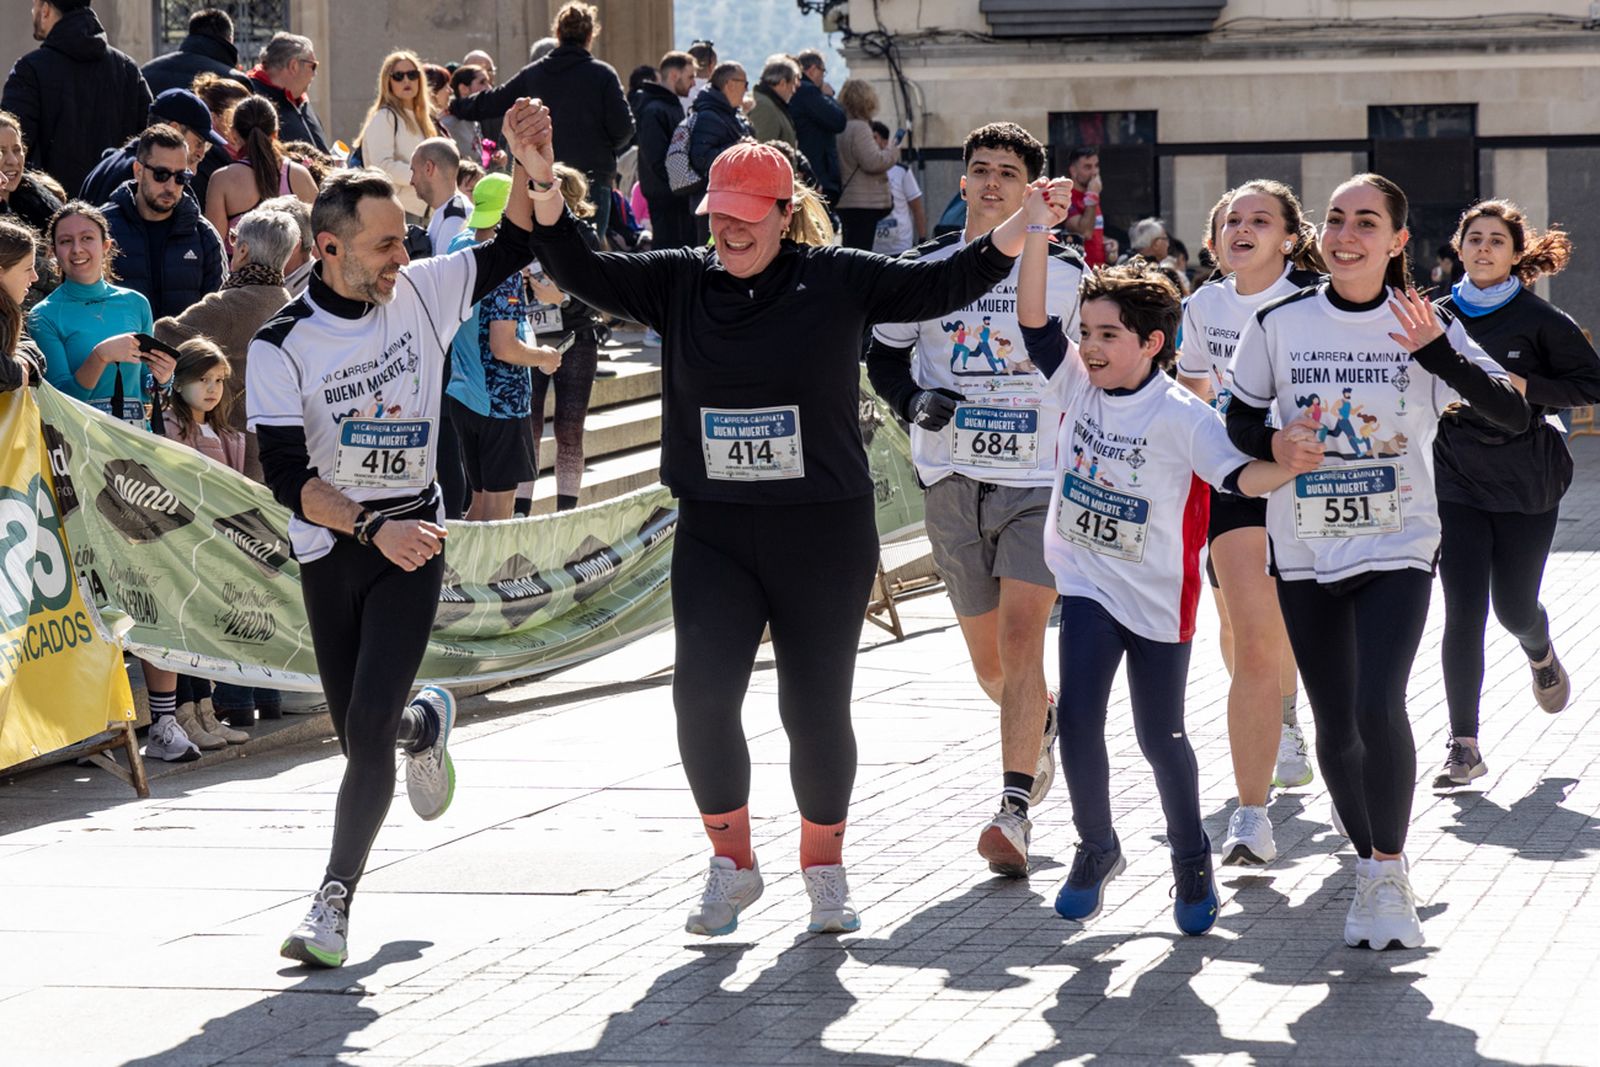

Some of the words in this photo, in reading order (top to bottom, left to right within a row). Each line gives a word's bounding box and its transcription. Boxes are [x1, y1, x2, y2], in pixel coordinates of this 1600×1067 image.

[977, 299, 1016, 312] MUERT
[1290, 352, 1300, 361] VI
[1302, 351, 1354, 362] CARRERA
[1356, 352, 1415, 362] CAMINATA
[322, 374, 332, 383] VI
[334, 359, 379, 380] CARRERA
[1291, 367, 1330, 384] BUENA
[1335, 367, 1389, 383] MUERTE
[324, 381, 365, 404] BUENA
[720, 416, 749, 424] CARRERA
[750, 413, 785, 423] CAMINATA
[972, 409, 998, 418] CARRERA
[999, 411, 1029, 419] CAMINATA
[361, 424, 390, 432] CARRERA
[713, 425, 738, 437] BUENA
[738, 425, 770, 437] MUERTE
[964, 418, 987, 428] BUENA
[987, 419, 1016, 430] MUERTE
[350, 433, 377, 445] BUENA
[378, 434, 408, 446] MUERTE
[972, 432, 1018, 455] 684
[1107, 433, 1147, 446] CAMINATA
[728, 440, 774, 465] 414
[362, 450, 406, 474] 416
[1314, 473, 1346, 481] CARRERA
[1347, 469, 1384, 480] CAMINATA
[1078, 481, 1103, 498] CARRERA
[1104, 492, 1139, 508] CAMINATA
[1306, 482, 1334, 495] BUENA
[1336, 481, 1369, 494] MUERTE
[1069, 488, 1090, 507] BUENA
[1091, 497, 1121, 517] MUERTE
[1324, 496, 1370, 523] 551
[1076, 510, 1118, 542] 415
